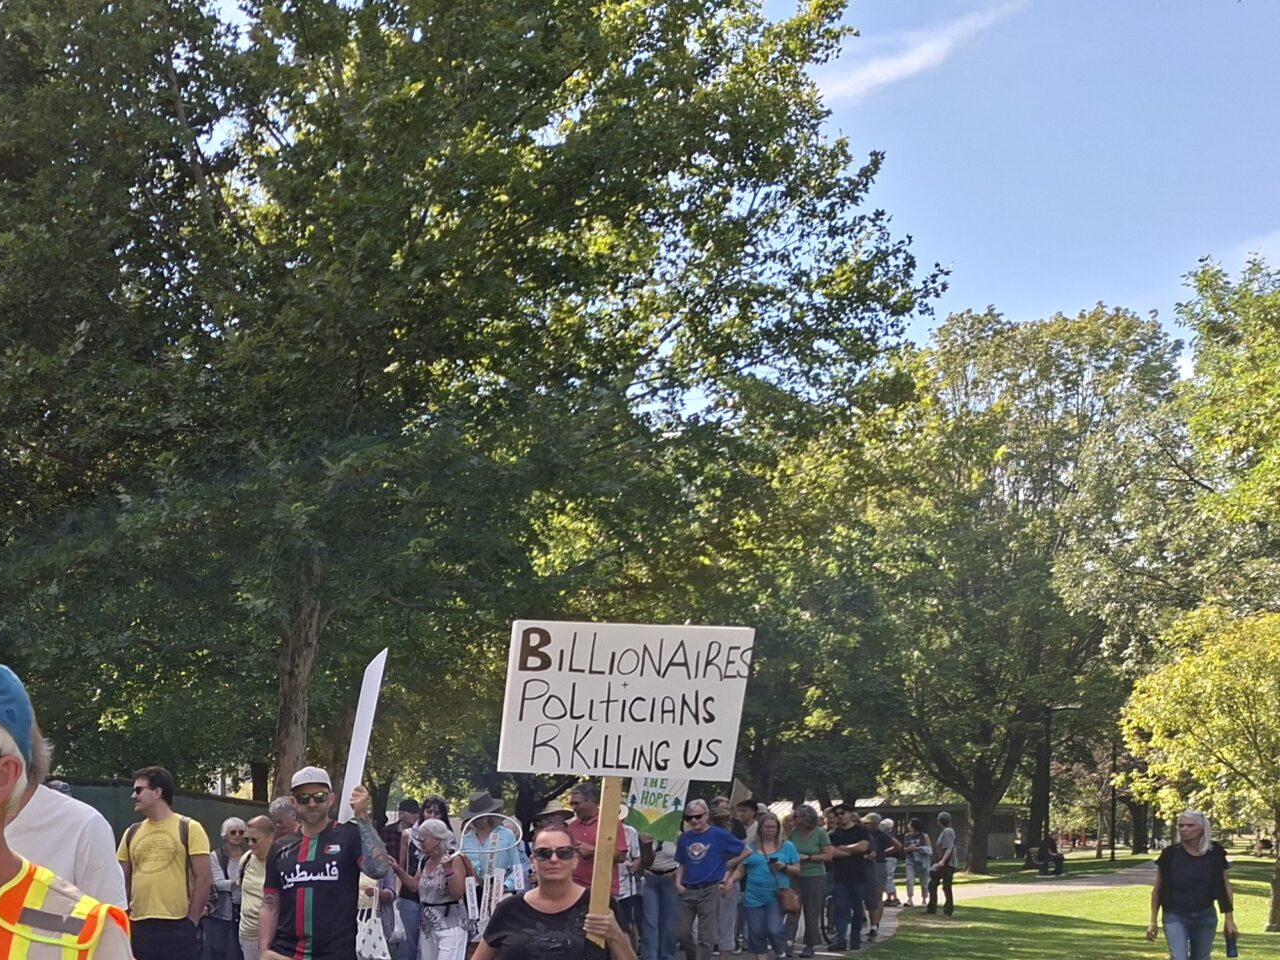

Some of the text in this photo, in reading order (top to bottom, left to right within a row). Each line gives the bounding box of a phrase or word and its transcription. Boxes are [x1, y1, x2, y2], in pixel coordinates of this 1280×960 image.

[518, 626, 753, 682] BILLIONAIRES
[530, 723, 723, 773] R KILLING US
[640, 789, 671, 808] HOPE
[643, 777, 669, 789] THE
[280, 859, 340, 890] فلسطين
